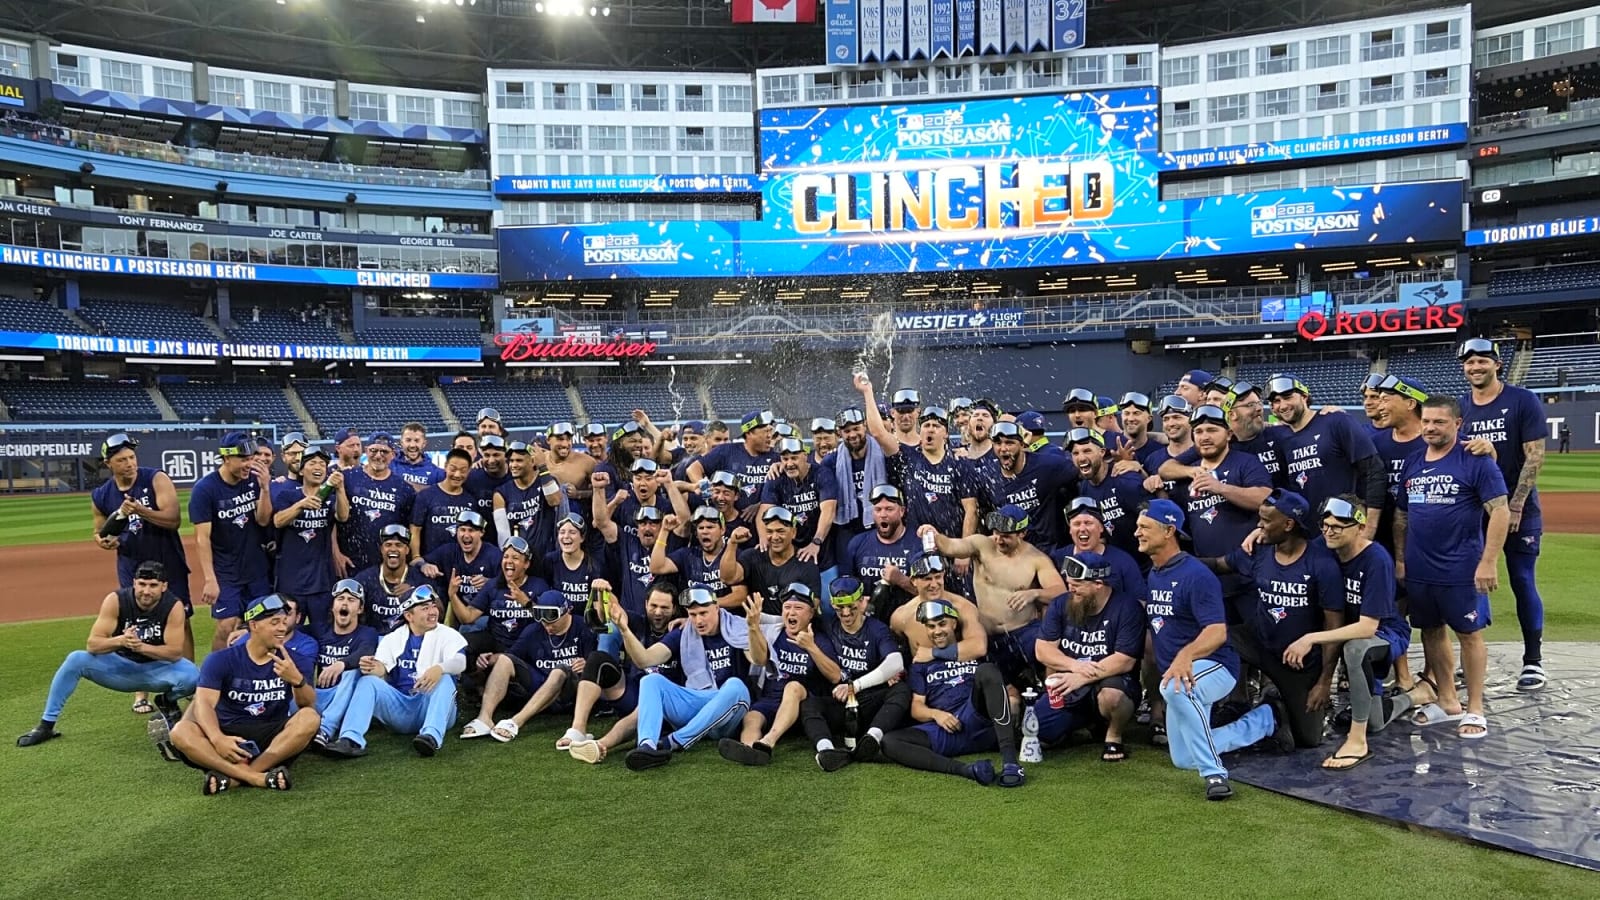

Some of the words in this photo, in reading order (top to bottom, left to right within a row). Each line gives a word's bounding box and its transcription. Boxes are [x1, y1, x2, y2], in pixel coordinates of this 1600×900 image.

[910, 5, 926, 16] 1991
[934, 3, 950, 15] 1992
[959, 1, 975, 13] 1993
[982, 0, 999, 11] 2015
[1055, 0, 1084, 20] 32
[863, 6, 879, 18] 1985
[886, 6, 901, 18] 1989
[863, 30, 878, 39] EAST
[886, 30, 901, 39] EAST
[911, 28, 926, 37] EAST
[897, 125, 1011, 147] POSTSEASON
[1245, 146, 1265, 161] JAYS
[1294, 140, 1339, 154] CLINCHED
[1343, 139, 1350, 148] A
[1353, 132, 1414, 148] POSTSEASON
[1417, 129, 1449, 140] BERTH
[511, 178, 548, 189] TORONTO
[551, 178, 570, 189] BLUE
[573, 178, 593, 189] JAYS
[596, 178, 616, 188] HAVE
[792, 160, 1114, 234] CLINCHED
[16, 204, 51, 216] CHEEK
[1278, 205, 1315, 215] 2023
[118, 215, 146, 226] TONY
[150, 218, 205, 233] FERNANDEZ
[1251, 214, 1360, 235] POSTSEASON
[268, 229, 286, 238] JOE
[290, 230, 322, 240] CARTER
[1483, 224, 1545, 243] TORONTO
[1551, 220, 1586, 236] BLUE
[400, 236, 433, 247] GEORGE
[437, 239, 455, 248] BELL
[605, 235, 637, 245] 2023
[584, 245, 679, 262] POSTSEASON
[3, 247, 38, 264] HAVE
[43, 250, 110, 271] CLINCHED
[115, 258, 124, 271] A
[128, 260, 212, 276] POSTSEASON
[217, 264, 256, 278] BERTH
[357, 272, 431, 288] CLINCHED
[895, 315, 967, 330] WESTJET
[991, 312, 1022, 321] FLIGHT
[1335, 304, 1463, 334] ROGERS
[994, 320, 1018, 328] DECK
[55, 335, 114, 351] TORONTO
[117, 339, 150, 353] BLUE
[153, 341, 183, 354] JAYS
[187, 341, 218, 355] HAVE
[222, 343, 280, 358] CLINCHED
[284, 345, 292, 358] A
[296, 346, 369, 359] POSTSEASON
[372, 347, 409, 360] BERTH
[494, 333, 656, 360] Budweiser
[1472, 417, 1505, 432] TAKE
[1467, 431, 1507, 442] TOBER
[1258, 450, 1276, 462] KE
[1292, 444, 1318, 459] TAKE
[746, 465, 770, 474] TAKE
[1288, 458, 1323, 475] CTOBER
[402, 473, 428, 484] TAKE
[854, 472, 864, 480] TA
[926, 471, 951, 484] TAKE
[1411, 475, 1453, 485] TORONTO
[921, 481, 952, 494] TOBER
[1427, 484, 1460, 495] JAYS
[232, 491, 256, 505] TAKE
[369, 489, 396, 502] TAKE
[793, 490, 816, 503] TAKE
[1006, 488, 1037, 503] TAKE
[352, 496, 396, 512] OCTOBER
[1100, 497, 1119, 510] AKE
[303, 508, 329, 518] TAKE
[291, 518, 328, 530] CTOBER
[432, 516, 457, 524] OCTO
[630, 562, 649, 574] OCTO
[878, 557, 906, 567] TAKE
[703, 571, 721, 581] TAK
[562, 582, 588, 592] TAKE
[1271, 580, 1307, 594] TAKE
[1345, 578, 1360, 592] KE
[387, 597, 401, 606] TA
[563, 592, 588, 602] OBER
[1080, 630, 1106, 643] TAKE
[552, 646, 578, 657] TAKE
[842, 645, 867, 659] TAKE
[1062, 639, 1108, 656] OCTOBER
[780, 650, 808, 664] TAKE
[779, 662, 808, 675] OBER
[839, 657, 868, 671] OBER
[926, 665, 979, 683] OCTOBER
[252, 678, 285, 690] TAKE
[228, 691, 286, 702] OCTOBER
